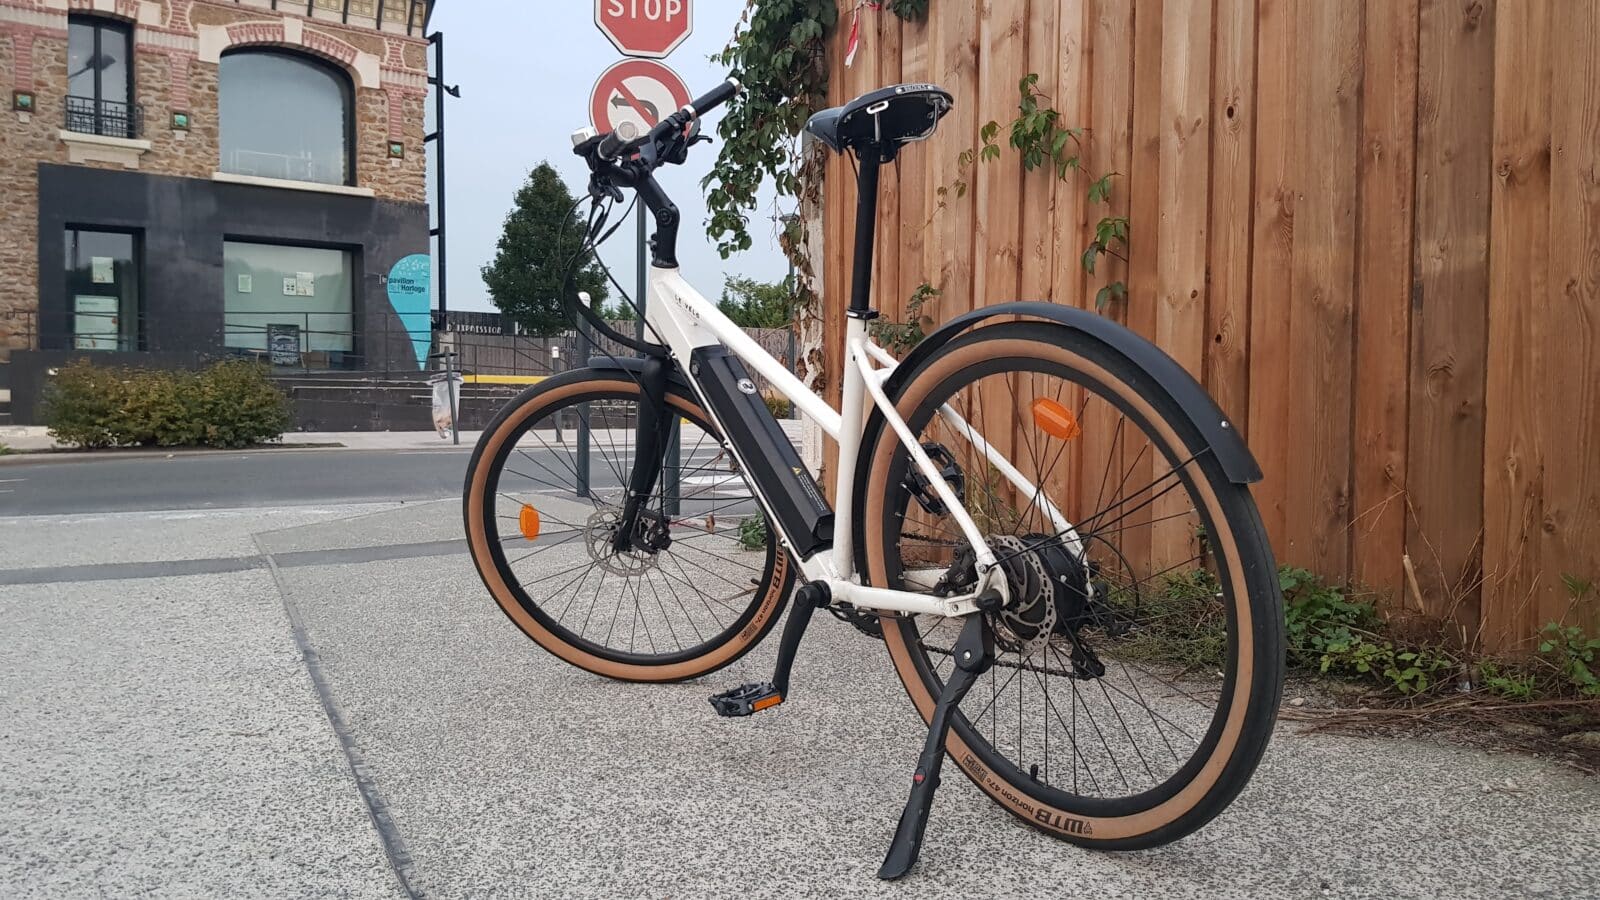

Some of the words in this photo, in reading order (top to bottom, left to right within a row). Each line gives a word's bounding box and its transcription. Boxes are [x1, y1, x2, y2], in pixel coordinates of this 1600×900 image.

[607, 0, 682, 22] STOP
[388, 277, 415, 285] pavillon
[1001, 788, 1035, 815] horizon
[1035, 808, 1083, 834] WTB
